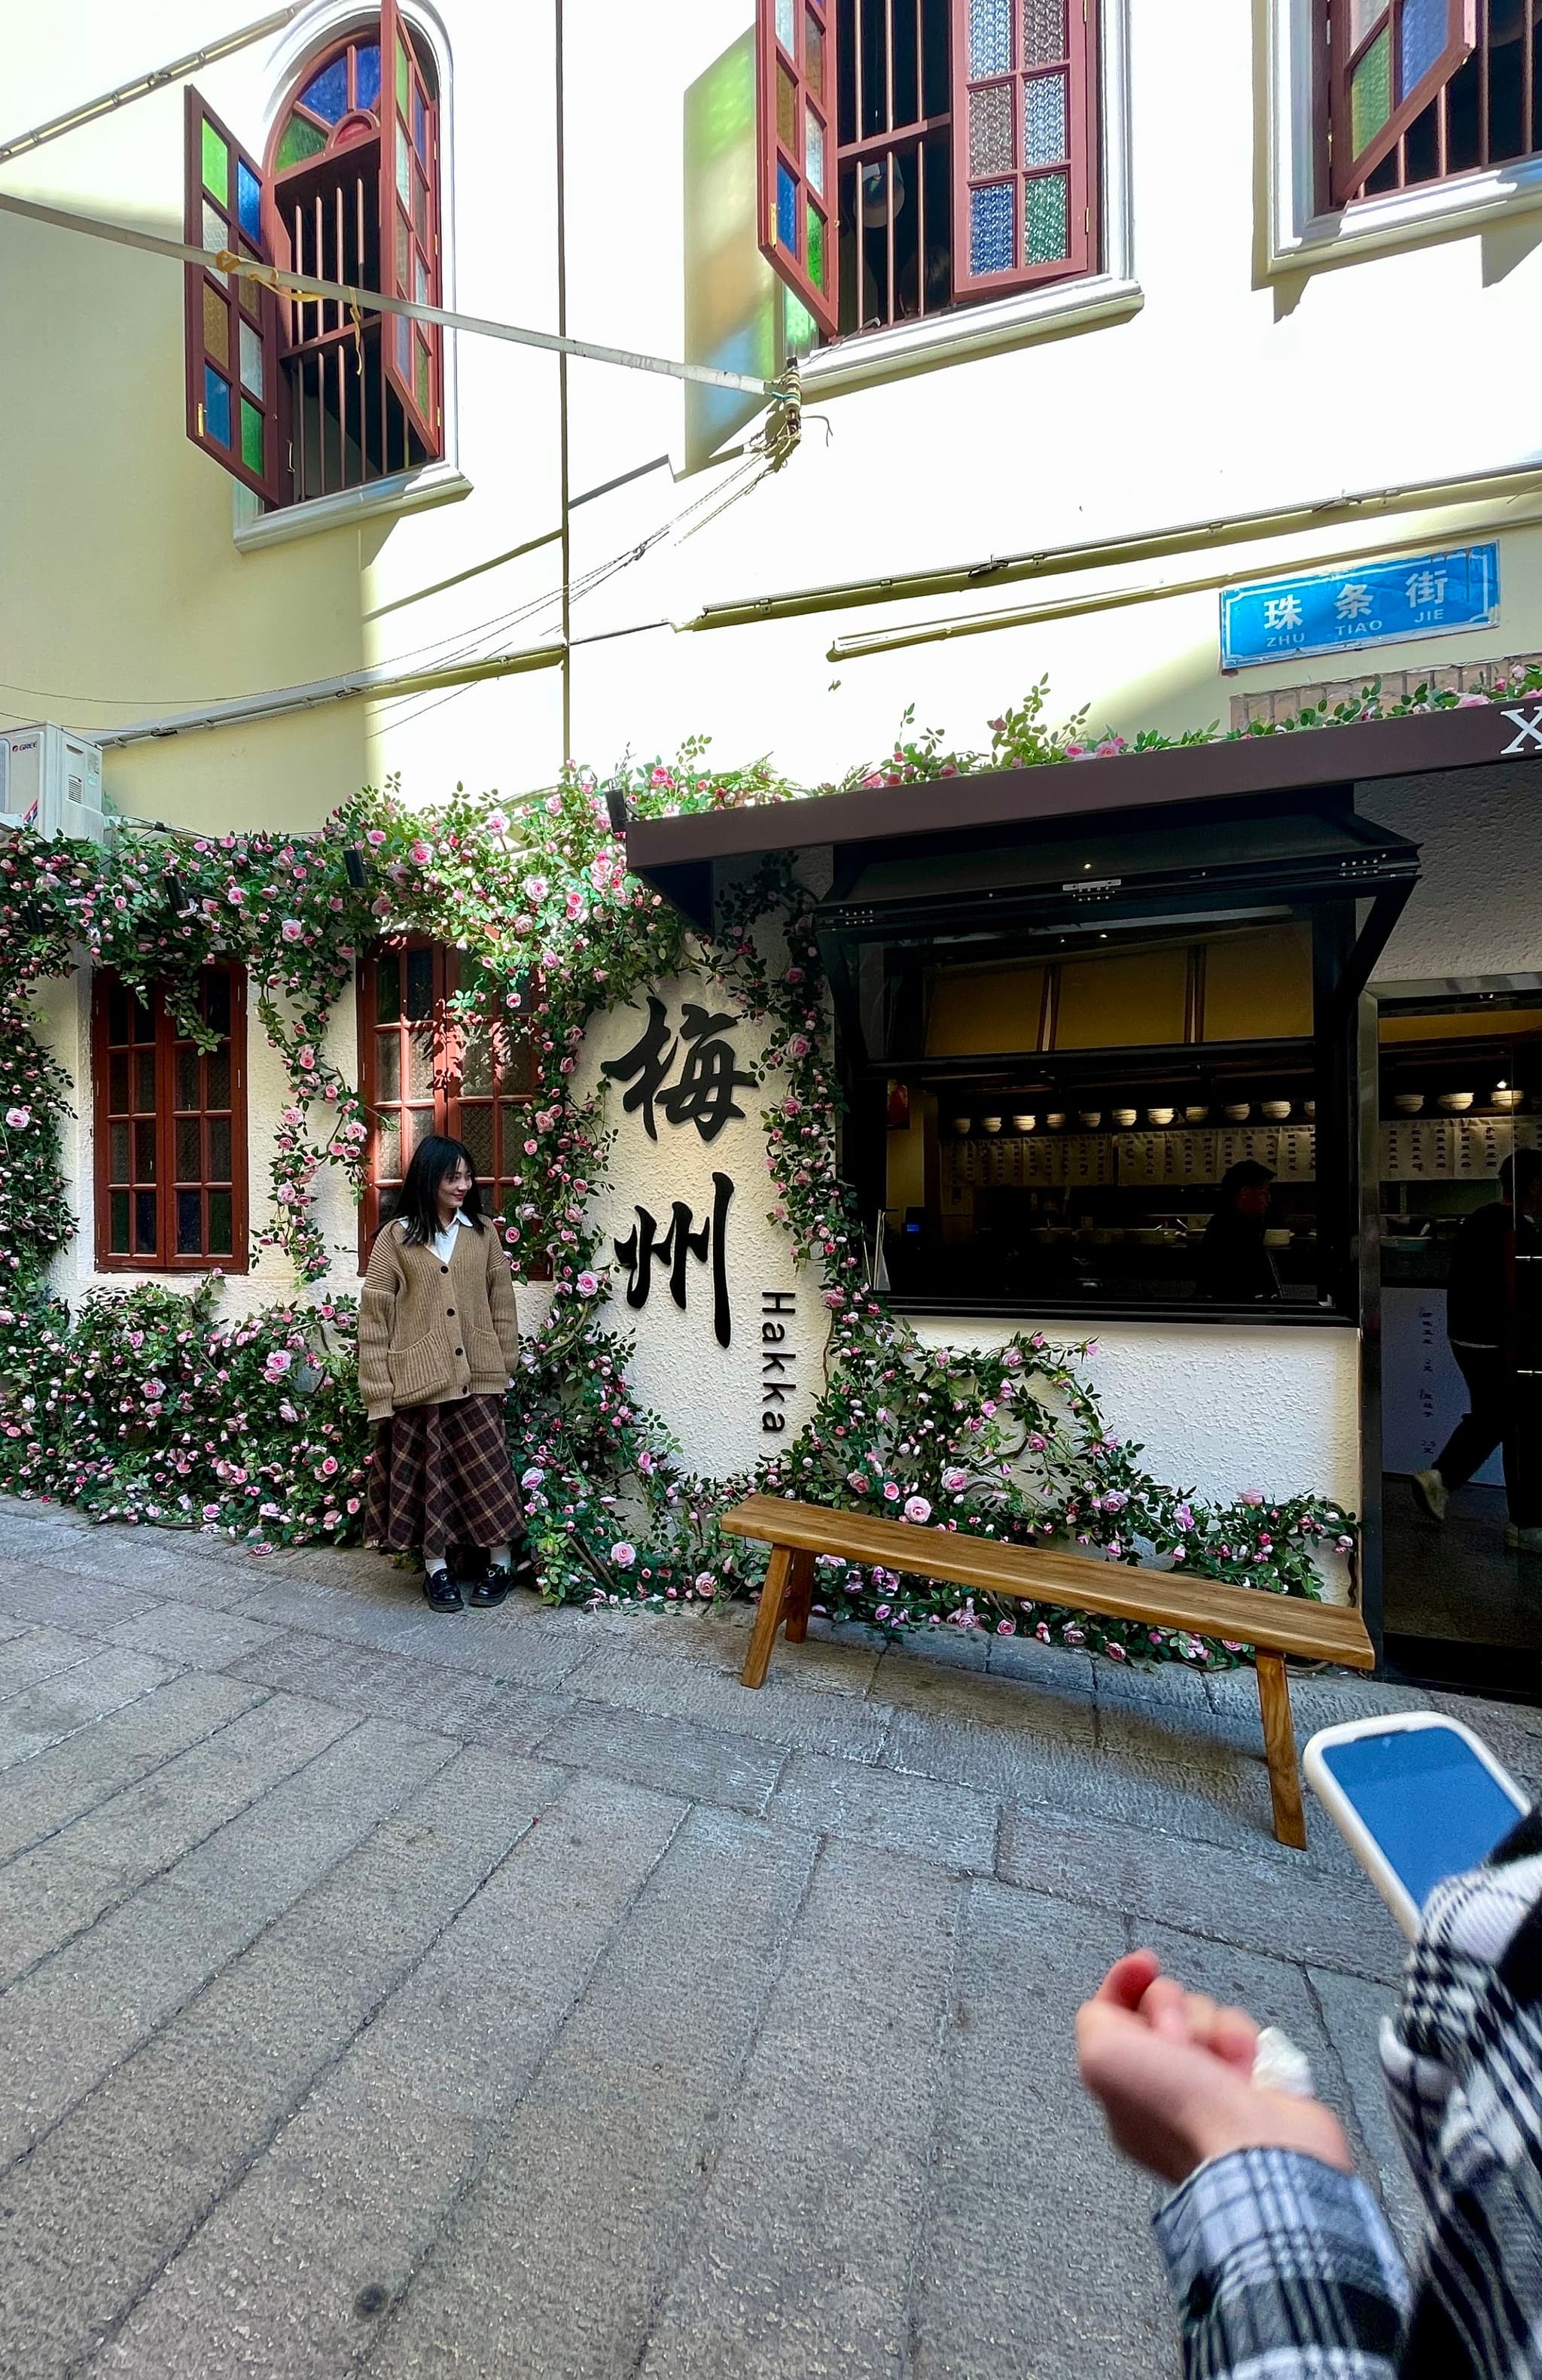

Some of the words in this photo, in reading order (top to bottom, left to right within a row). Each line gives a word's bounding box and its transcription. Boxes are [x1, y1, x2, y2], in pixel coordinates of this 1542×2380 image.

[1263, 569, 1449, 631] 珠条街
[1266, 632, 1306, 648] ZHU
[1335, 619, 1383, 637] TIAO
[1414, 608, 1445, 624] JIE
[1500, 705, 1542, 755] X
[602, 995, 760, 1350] 梅州
[760, 1291, 797, 1433] Hakka
